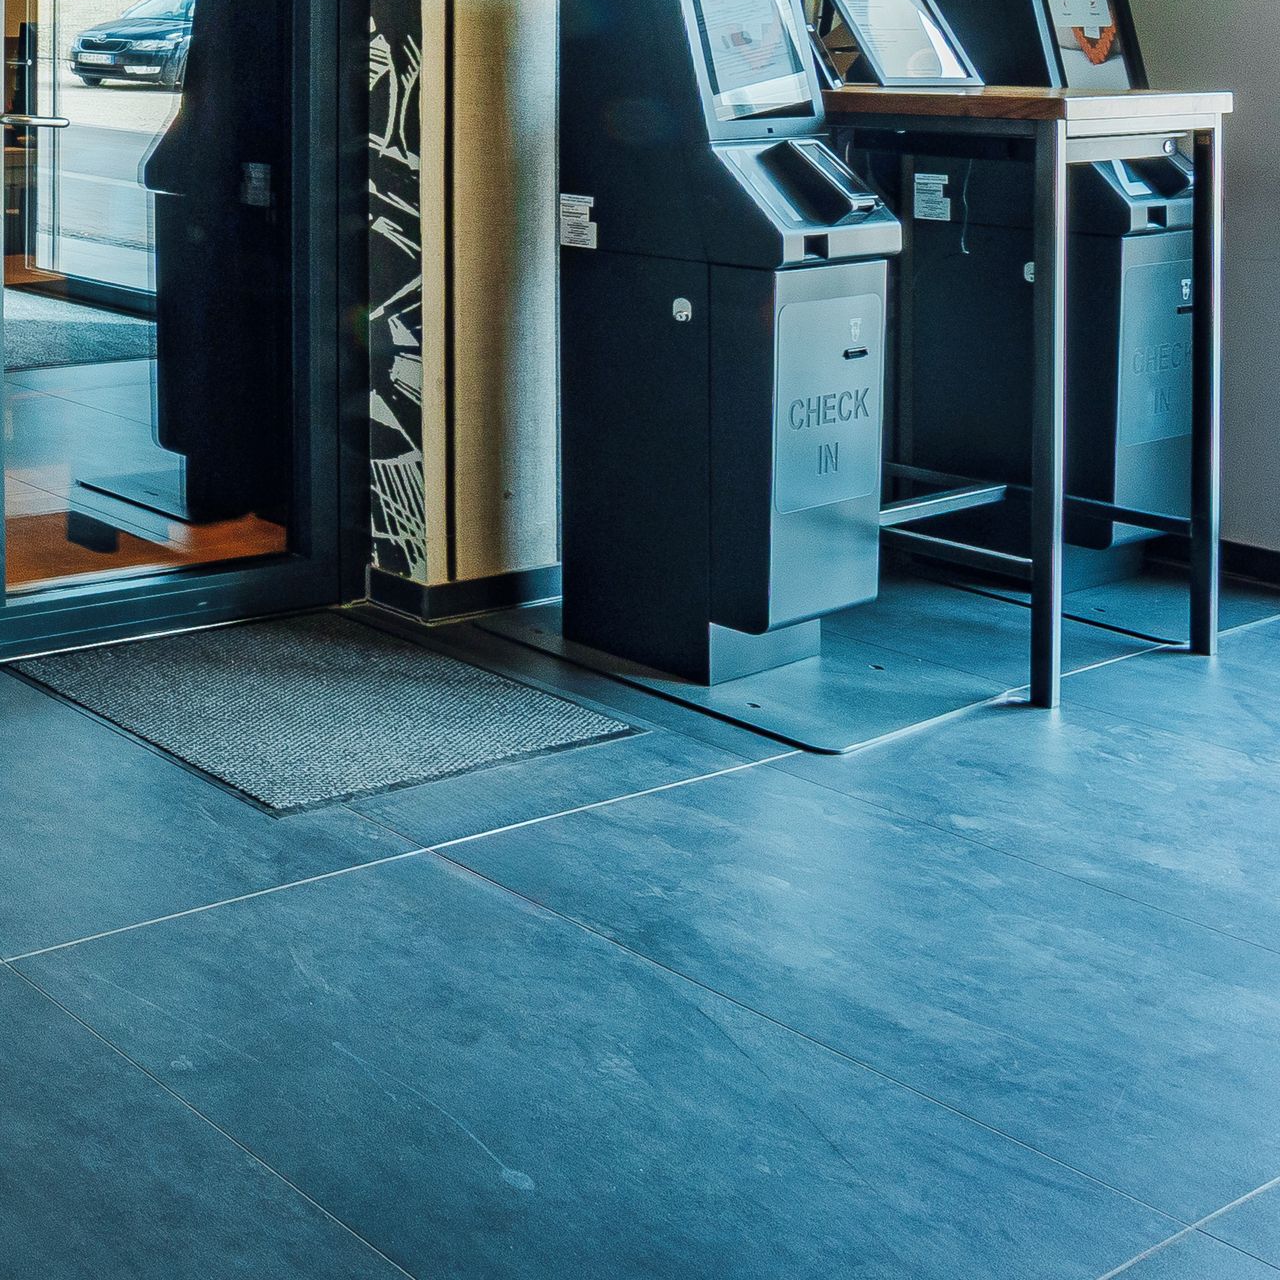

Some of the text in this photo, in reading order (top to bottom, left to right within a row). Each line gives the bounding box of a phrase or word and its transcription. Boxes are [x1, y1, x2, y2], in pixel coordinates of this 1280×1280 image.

[788, 386, 871, 432] CHECK
[1152, 386, 1171, 416] IN
[816, 442, 840, 476] IN
